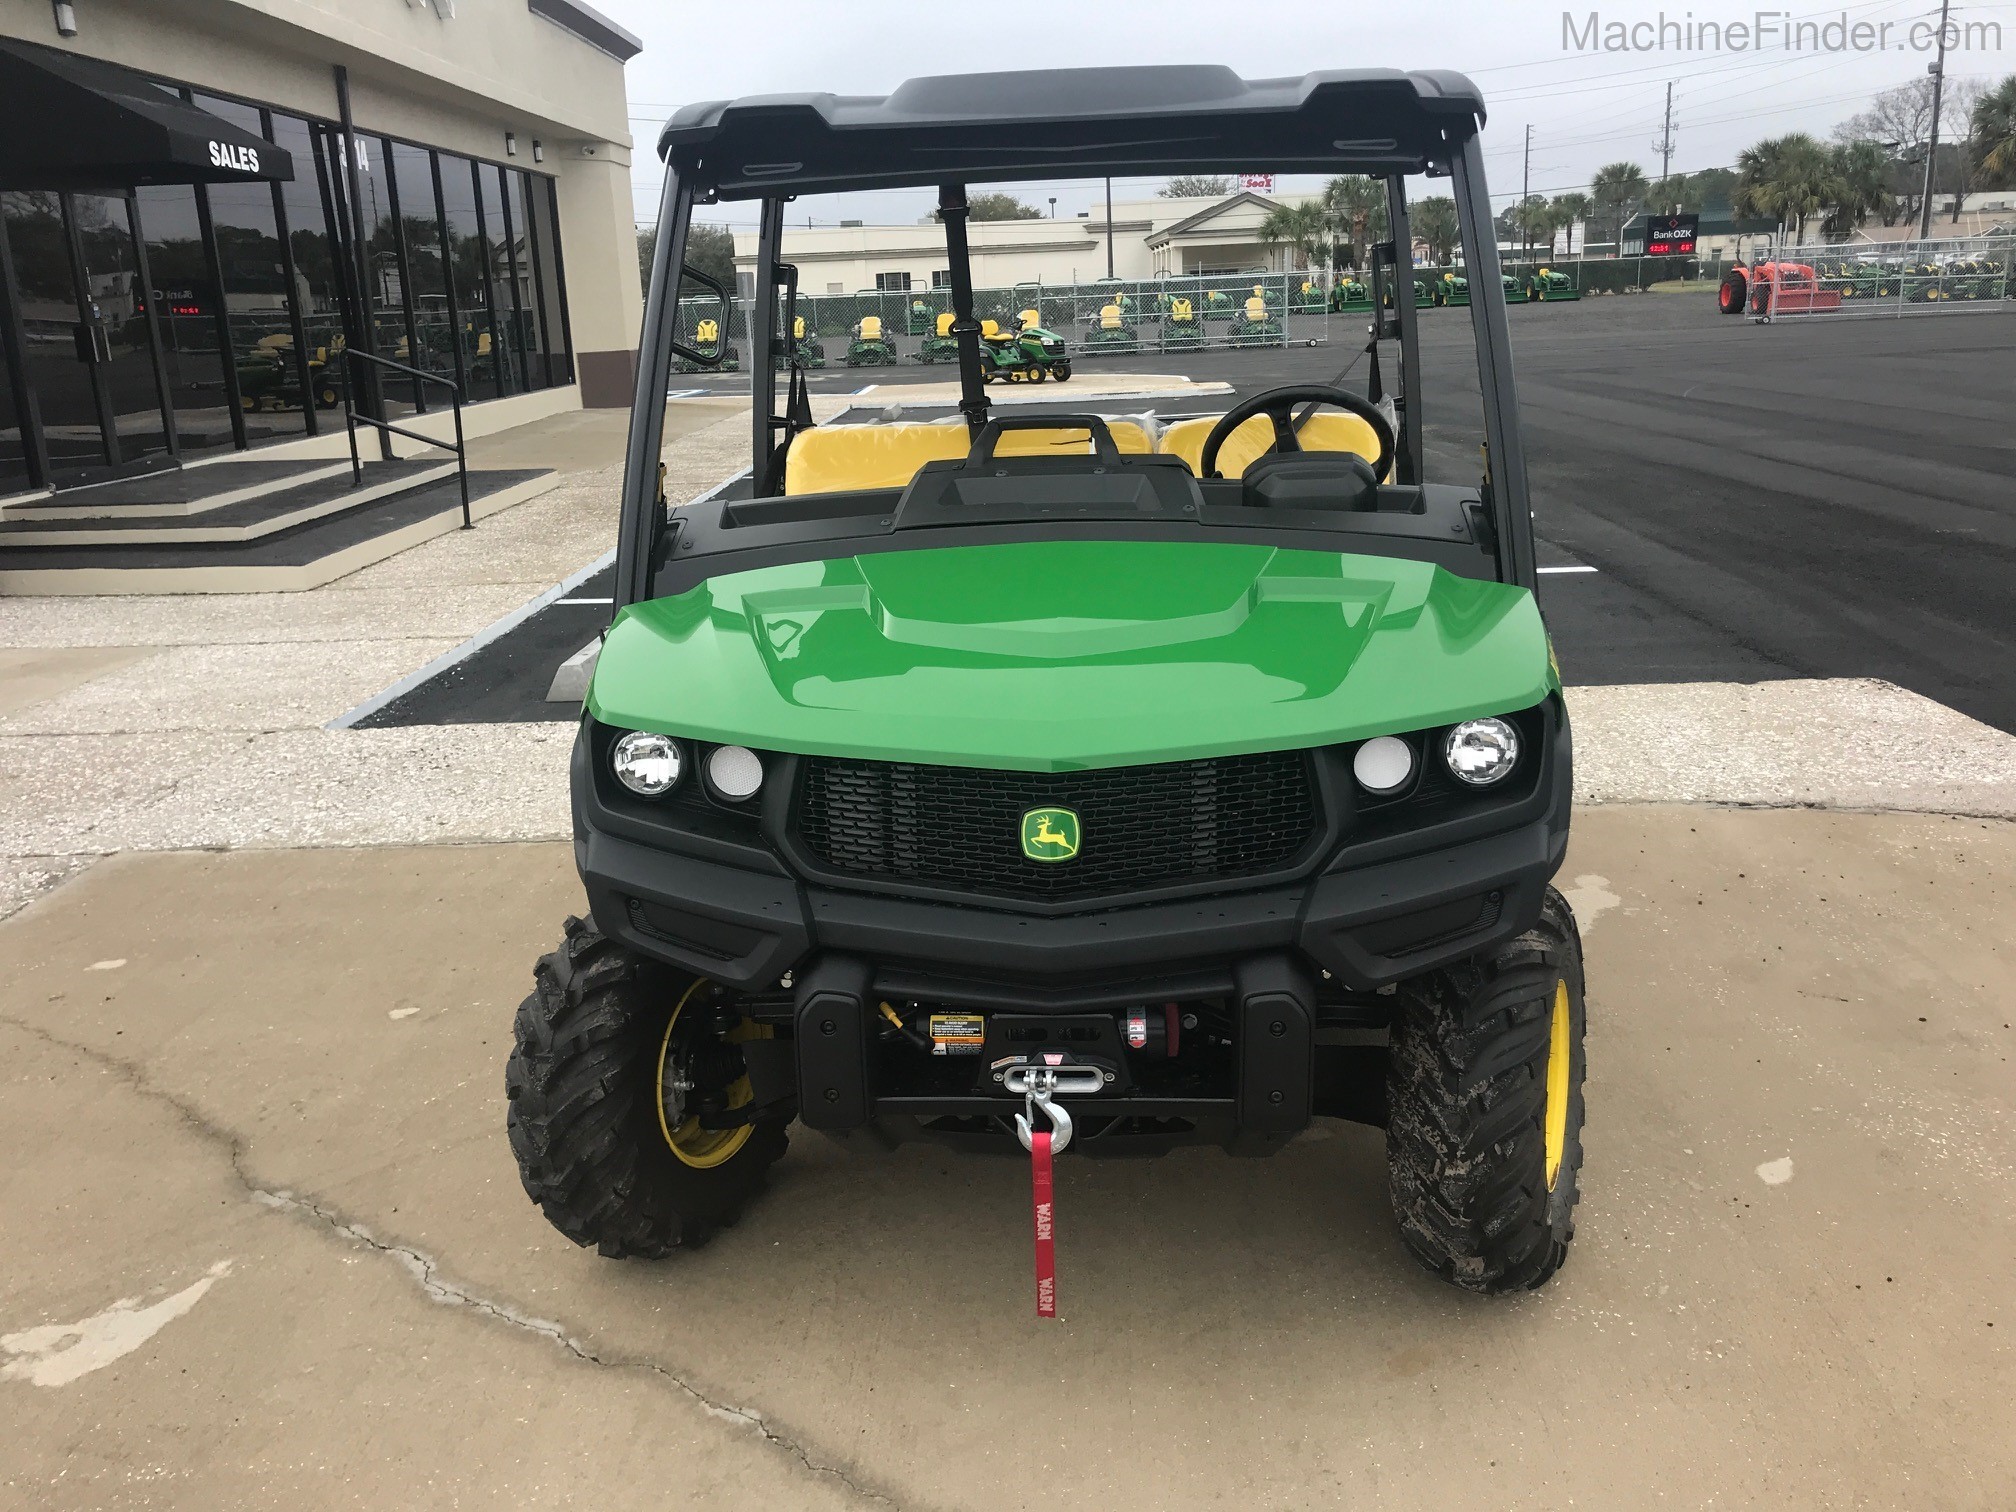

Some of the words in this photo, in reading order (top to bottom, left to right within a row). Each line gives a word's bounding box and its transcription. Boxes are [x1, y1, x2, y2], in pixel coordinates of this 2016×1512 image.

[208, 140, 259, 172] SALES
[1037, 1203, 1051, 1240] WARN
[1039, 1277, 1053, 1312] WARN
